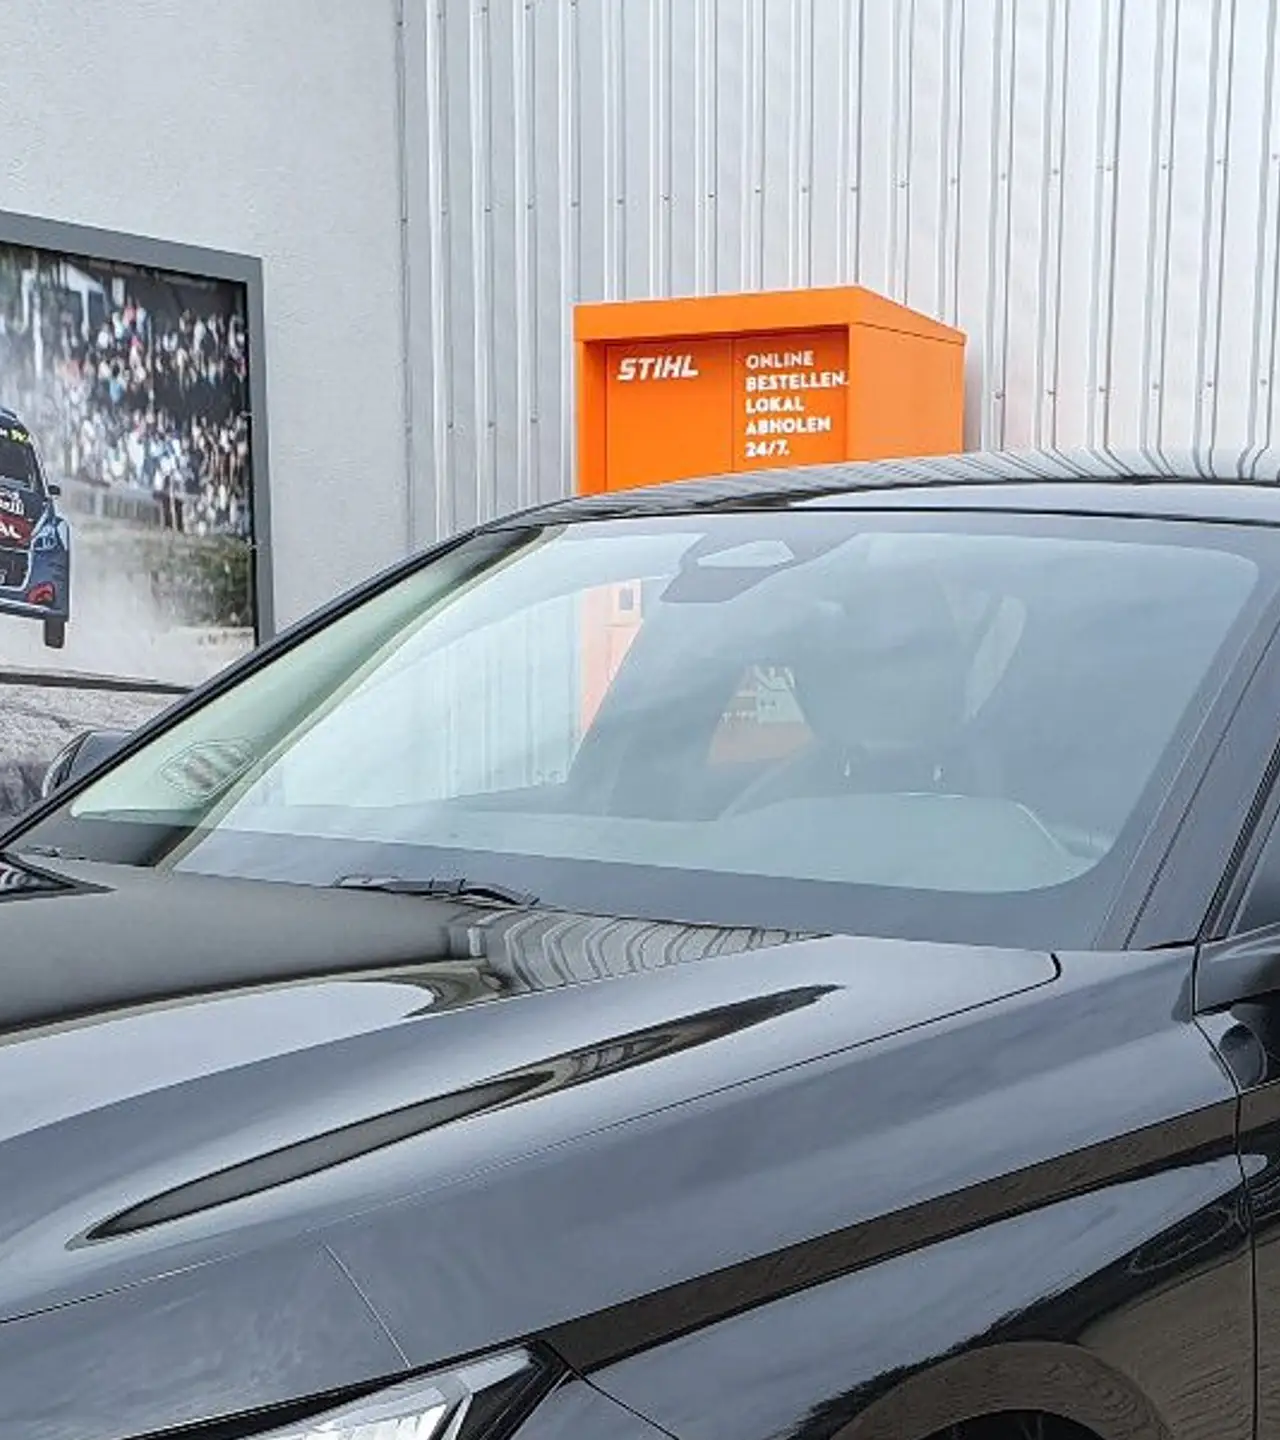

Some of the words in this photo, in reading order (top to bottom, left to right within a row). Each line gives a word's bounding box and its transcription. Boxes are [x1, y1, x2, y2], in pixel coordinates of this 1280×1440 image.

[617, 355, 699, 381] STIHL
[745, 350, 814, 369] ONLINE
[745, 396, 805, 413] LOKAL
[745, 415, 831, 436] ABHOLEN
[744, 439, 789, 458] 24/7.
